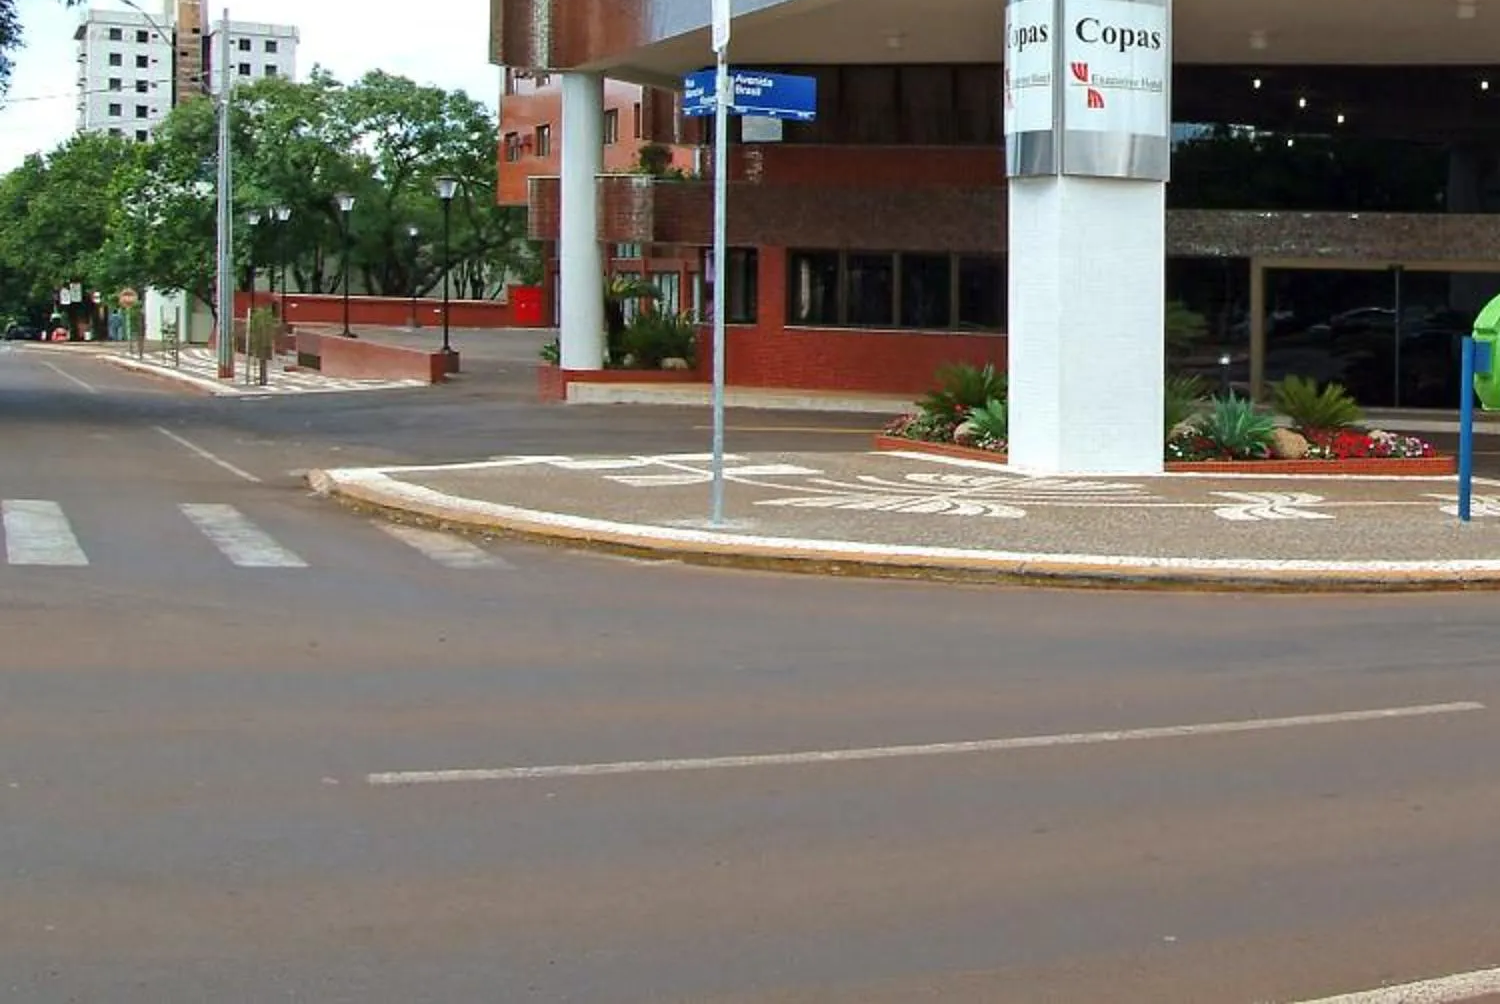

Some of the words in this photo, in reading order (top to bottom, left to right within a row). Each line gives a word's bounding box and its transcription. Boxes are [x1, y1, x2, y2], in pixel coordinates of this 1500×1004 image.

[1075, 16, 1161, 53] Copas
[735, 73, 774, 88] Avenida
[735, 84, 762, 97] Brasil
